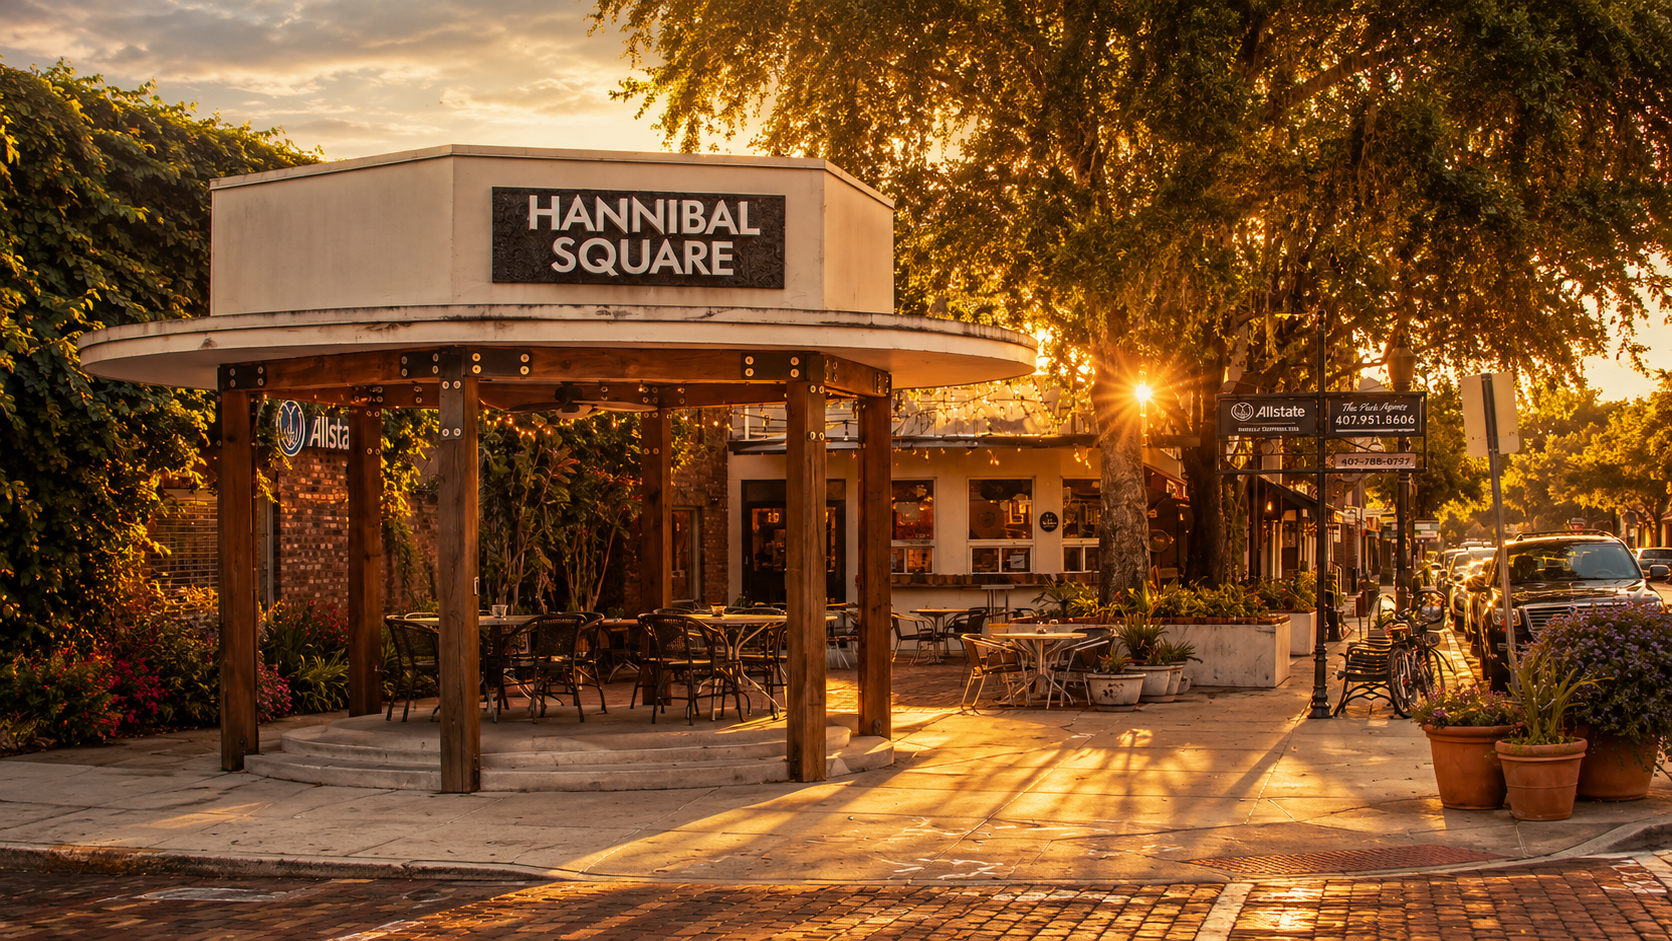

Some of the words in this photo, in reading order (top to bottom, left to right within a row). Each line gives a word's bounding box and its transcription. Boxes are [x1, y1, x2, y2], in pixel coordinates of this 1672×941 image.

[527, 194, 761, 236] HANNIBAL
[551, 236, 734, 277] SQUARE
[1255, 405, 1306, 418] Allstate
[1342, 402, 1358, 412] The
[1335, 414, 1416, 425] 407.951.8606
[308, 416, 349, 450] Allsta
